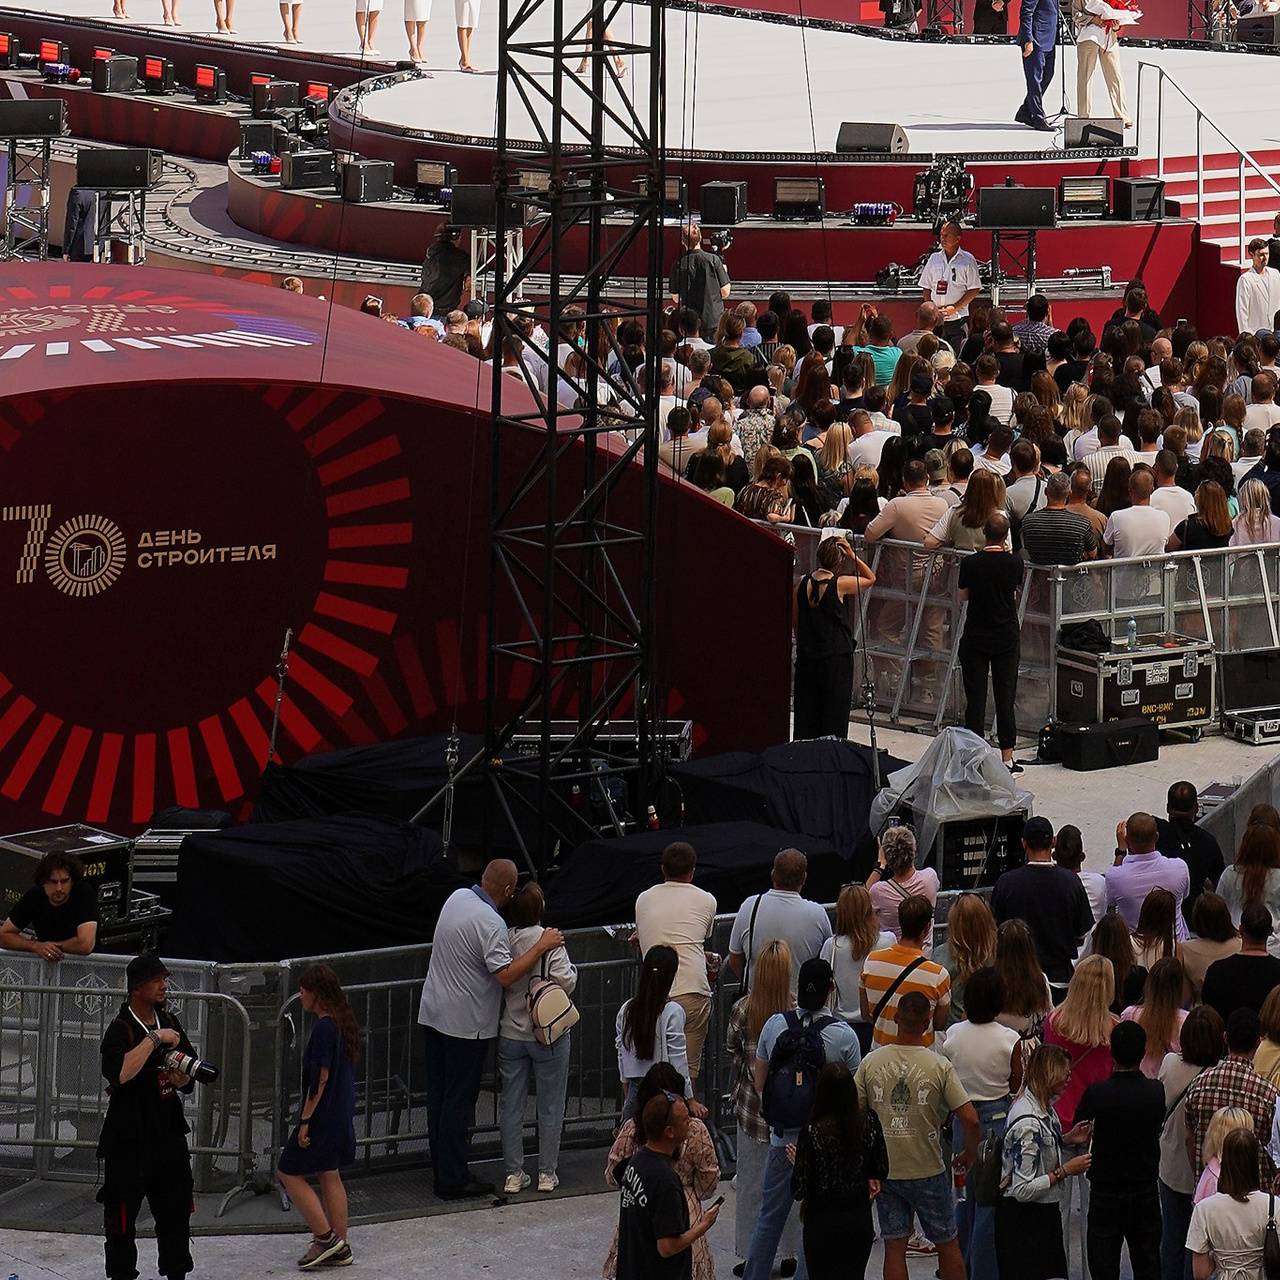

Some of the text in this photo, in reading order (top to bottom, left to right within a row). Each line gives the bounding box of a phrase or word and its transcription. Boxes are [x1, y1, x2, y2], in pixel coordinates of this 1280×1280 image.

[137, 529, 202, 548] ДЕНЬ
[137, 544, 277, 569] СТРОИТЕЛЯ
[82, 861, 107, 877] ION
